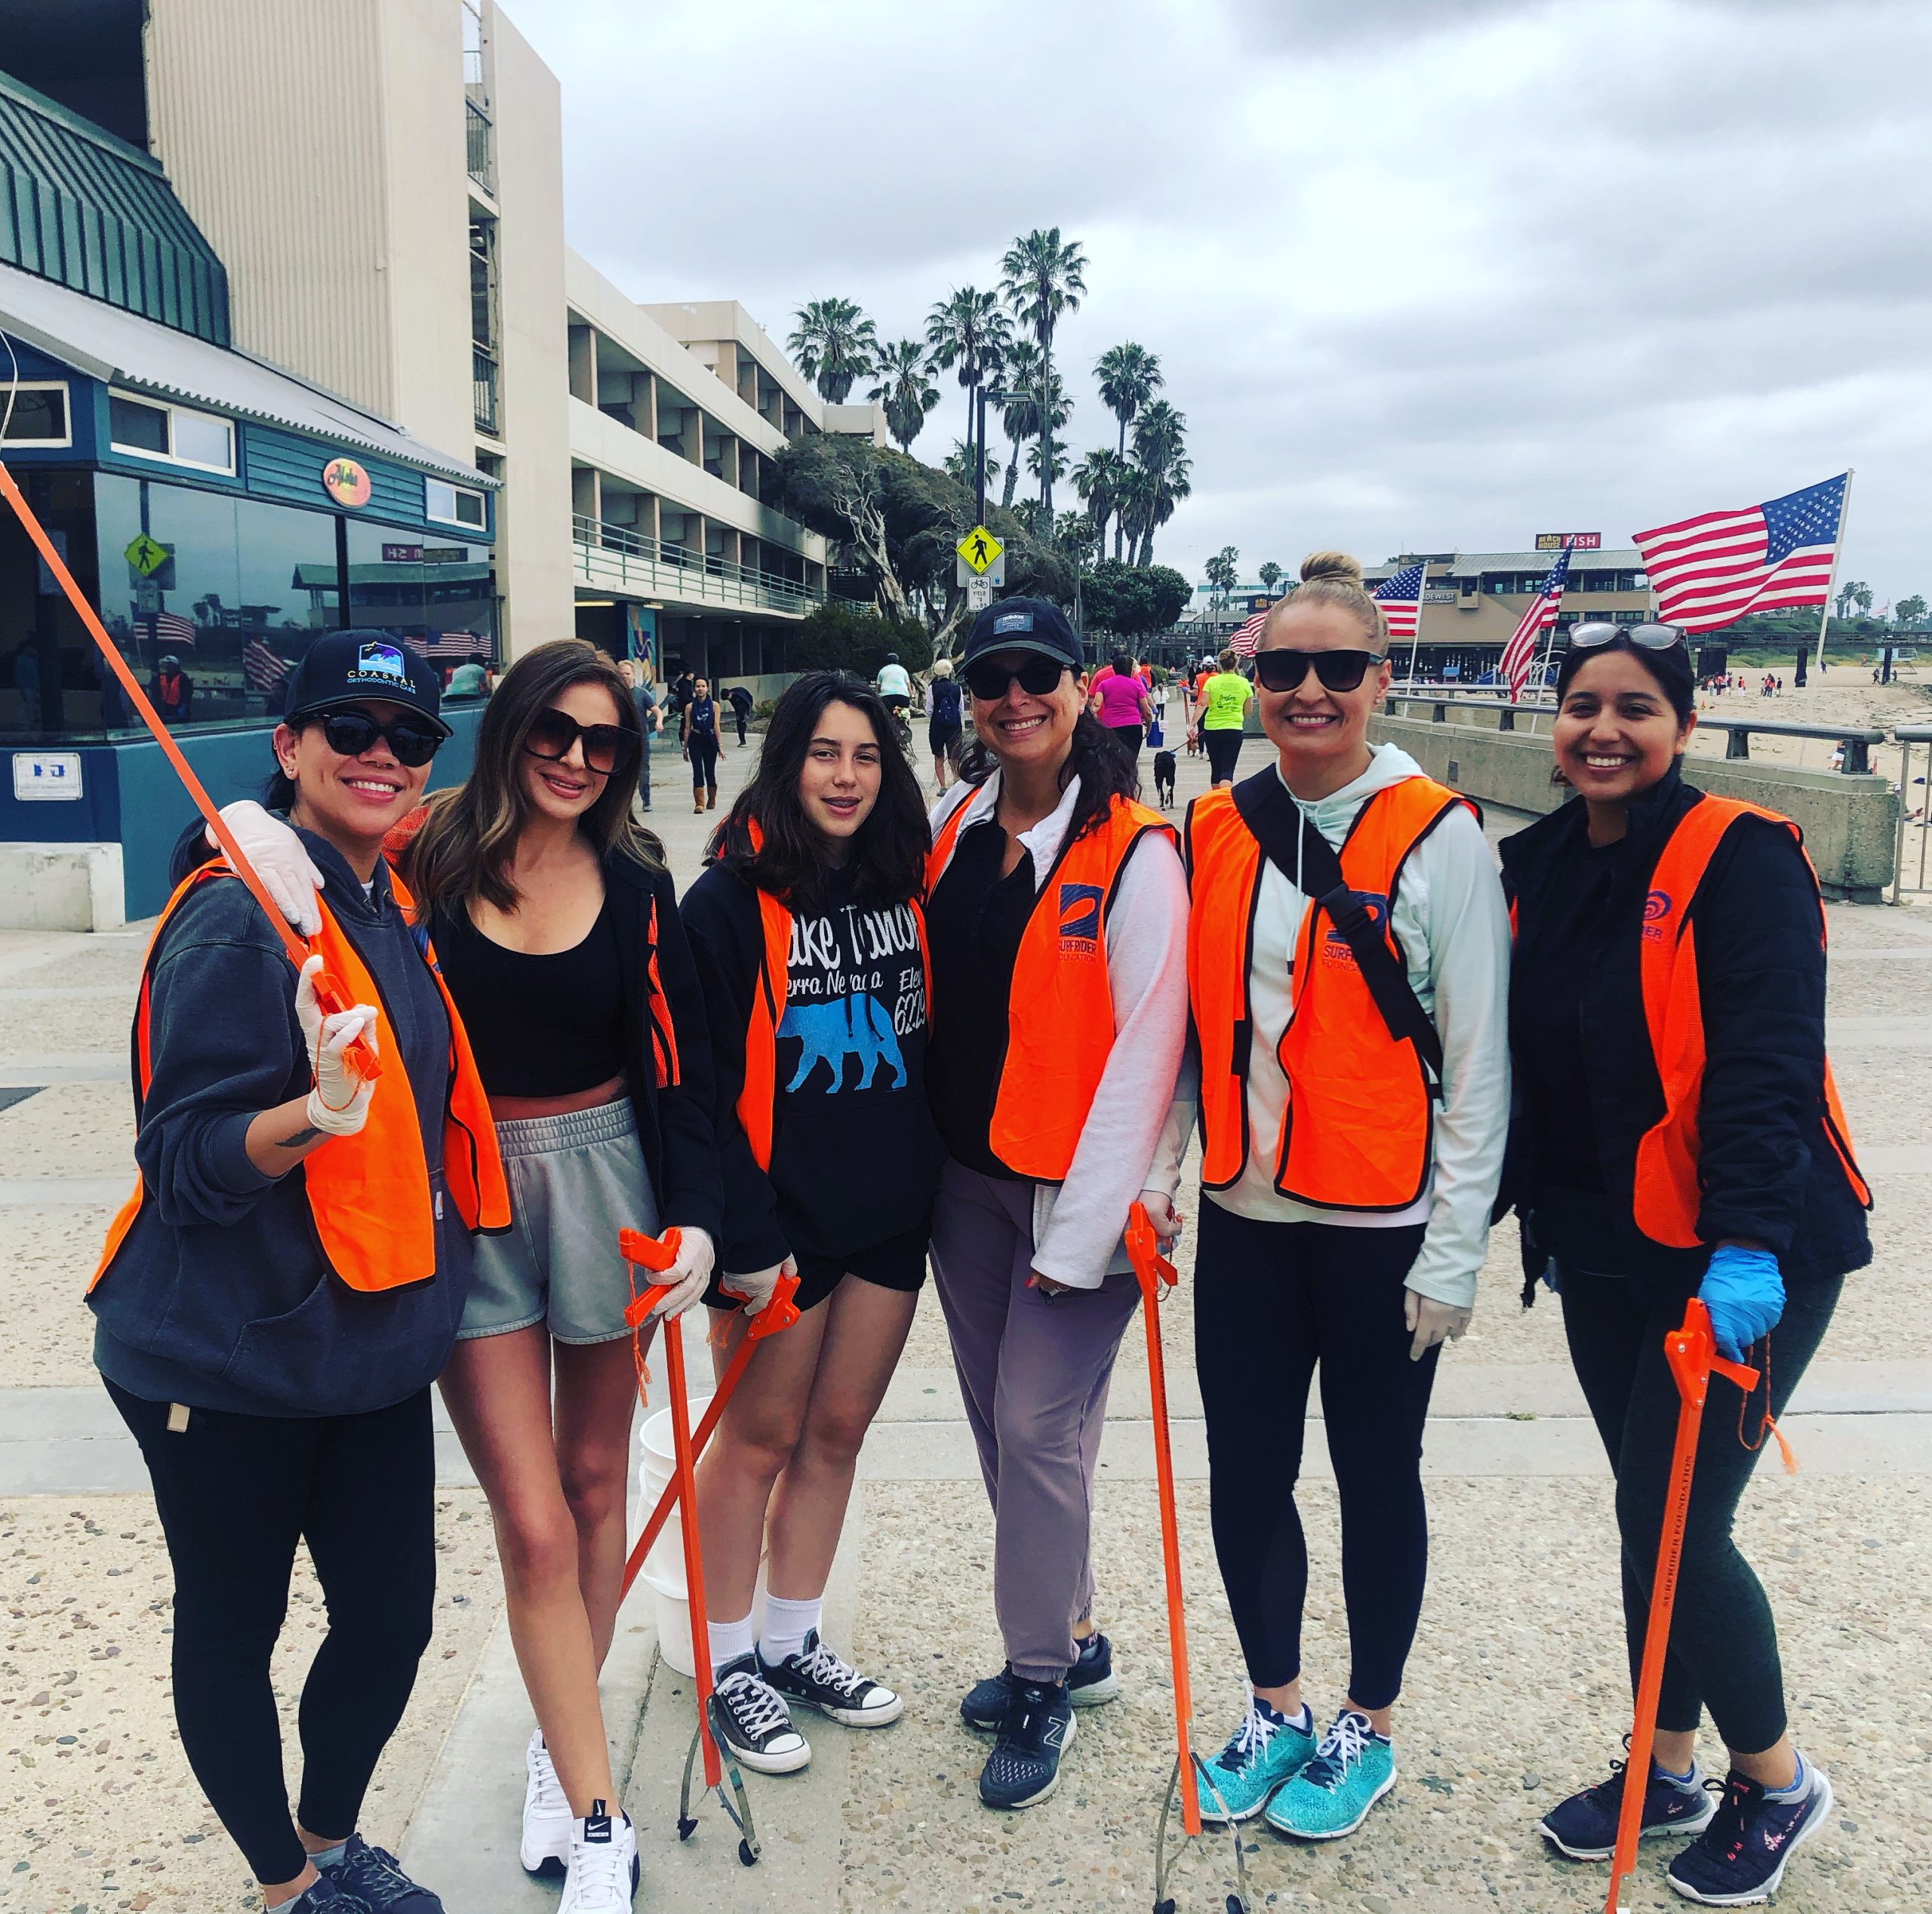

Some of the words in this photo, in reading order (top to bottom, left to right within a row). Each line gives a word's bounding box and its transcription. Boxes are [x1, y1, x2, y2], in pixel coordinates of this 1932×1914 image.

[1566, 537, 1595, 546] FISH
[347, 670, 416, 688] COASTAL
[347, 678, 398, 688] ORTHODONTIC
[399, 685, 416, 694] CARE
[787, 913, 841, 970] ake
[1059, 953, 1096, 964] OUNDATION
[1663, 1537, 1680, 1607] SURFRIDER
[1674, 1455, 1692, 1534] FOUNDATION
